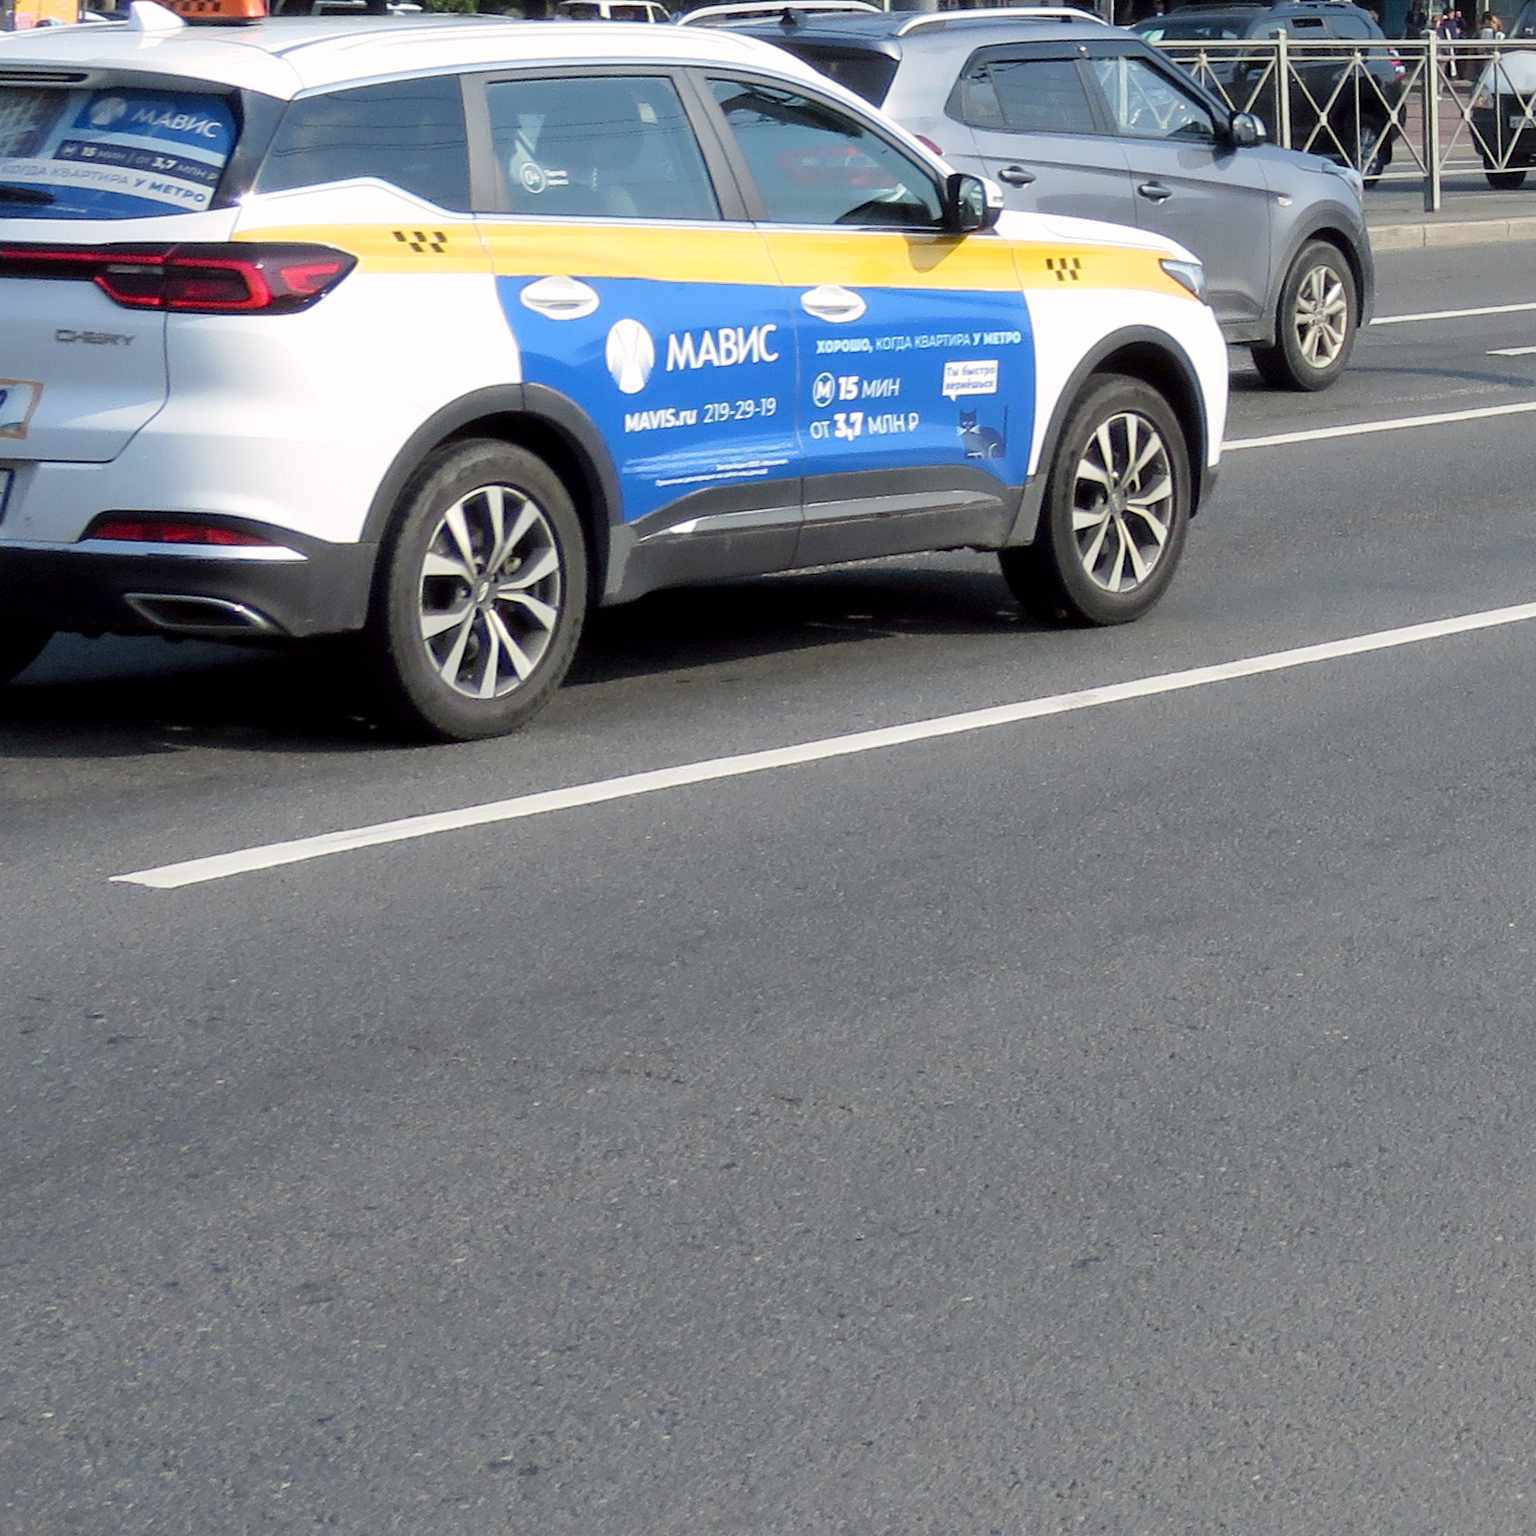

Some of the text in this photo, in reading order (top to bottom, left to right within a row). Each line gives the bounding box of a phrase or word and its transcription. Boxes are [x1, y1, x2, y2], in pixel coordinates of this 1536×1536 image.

[131, 107, 225, 139] МАВИС
[80, 146, 97, 158] 15
[149, 181, 207, 202] МЕТРО
[666, 323, 780, 372] МАВИС
[816, 331, 1022, 354] ХОРОШО, КОГДА КВАРТИРА У МЕТРО
[838, 376, 858, 400] 15
[861, 378, 901, 399] МИН
[624, 397, 777, 433] MAVIS.ru 219-29-19
[810, 420, 830, 439] ОТ
[834, 412, 864, 442] 3,7
[868, 415, 906, 434] МЛН
